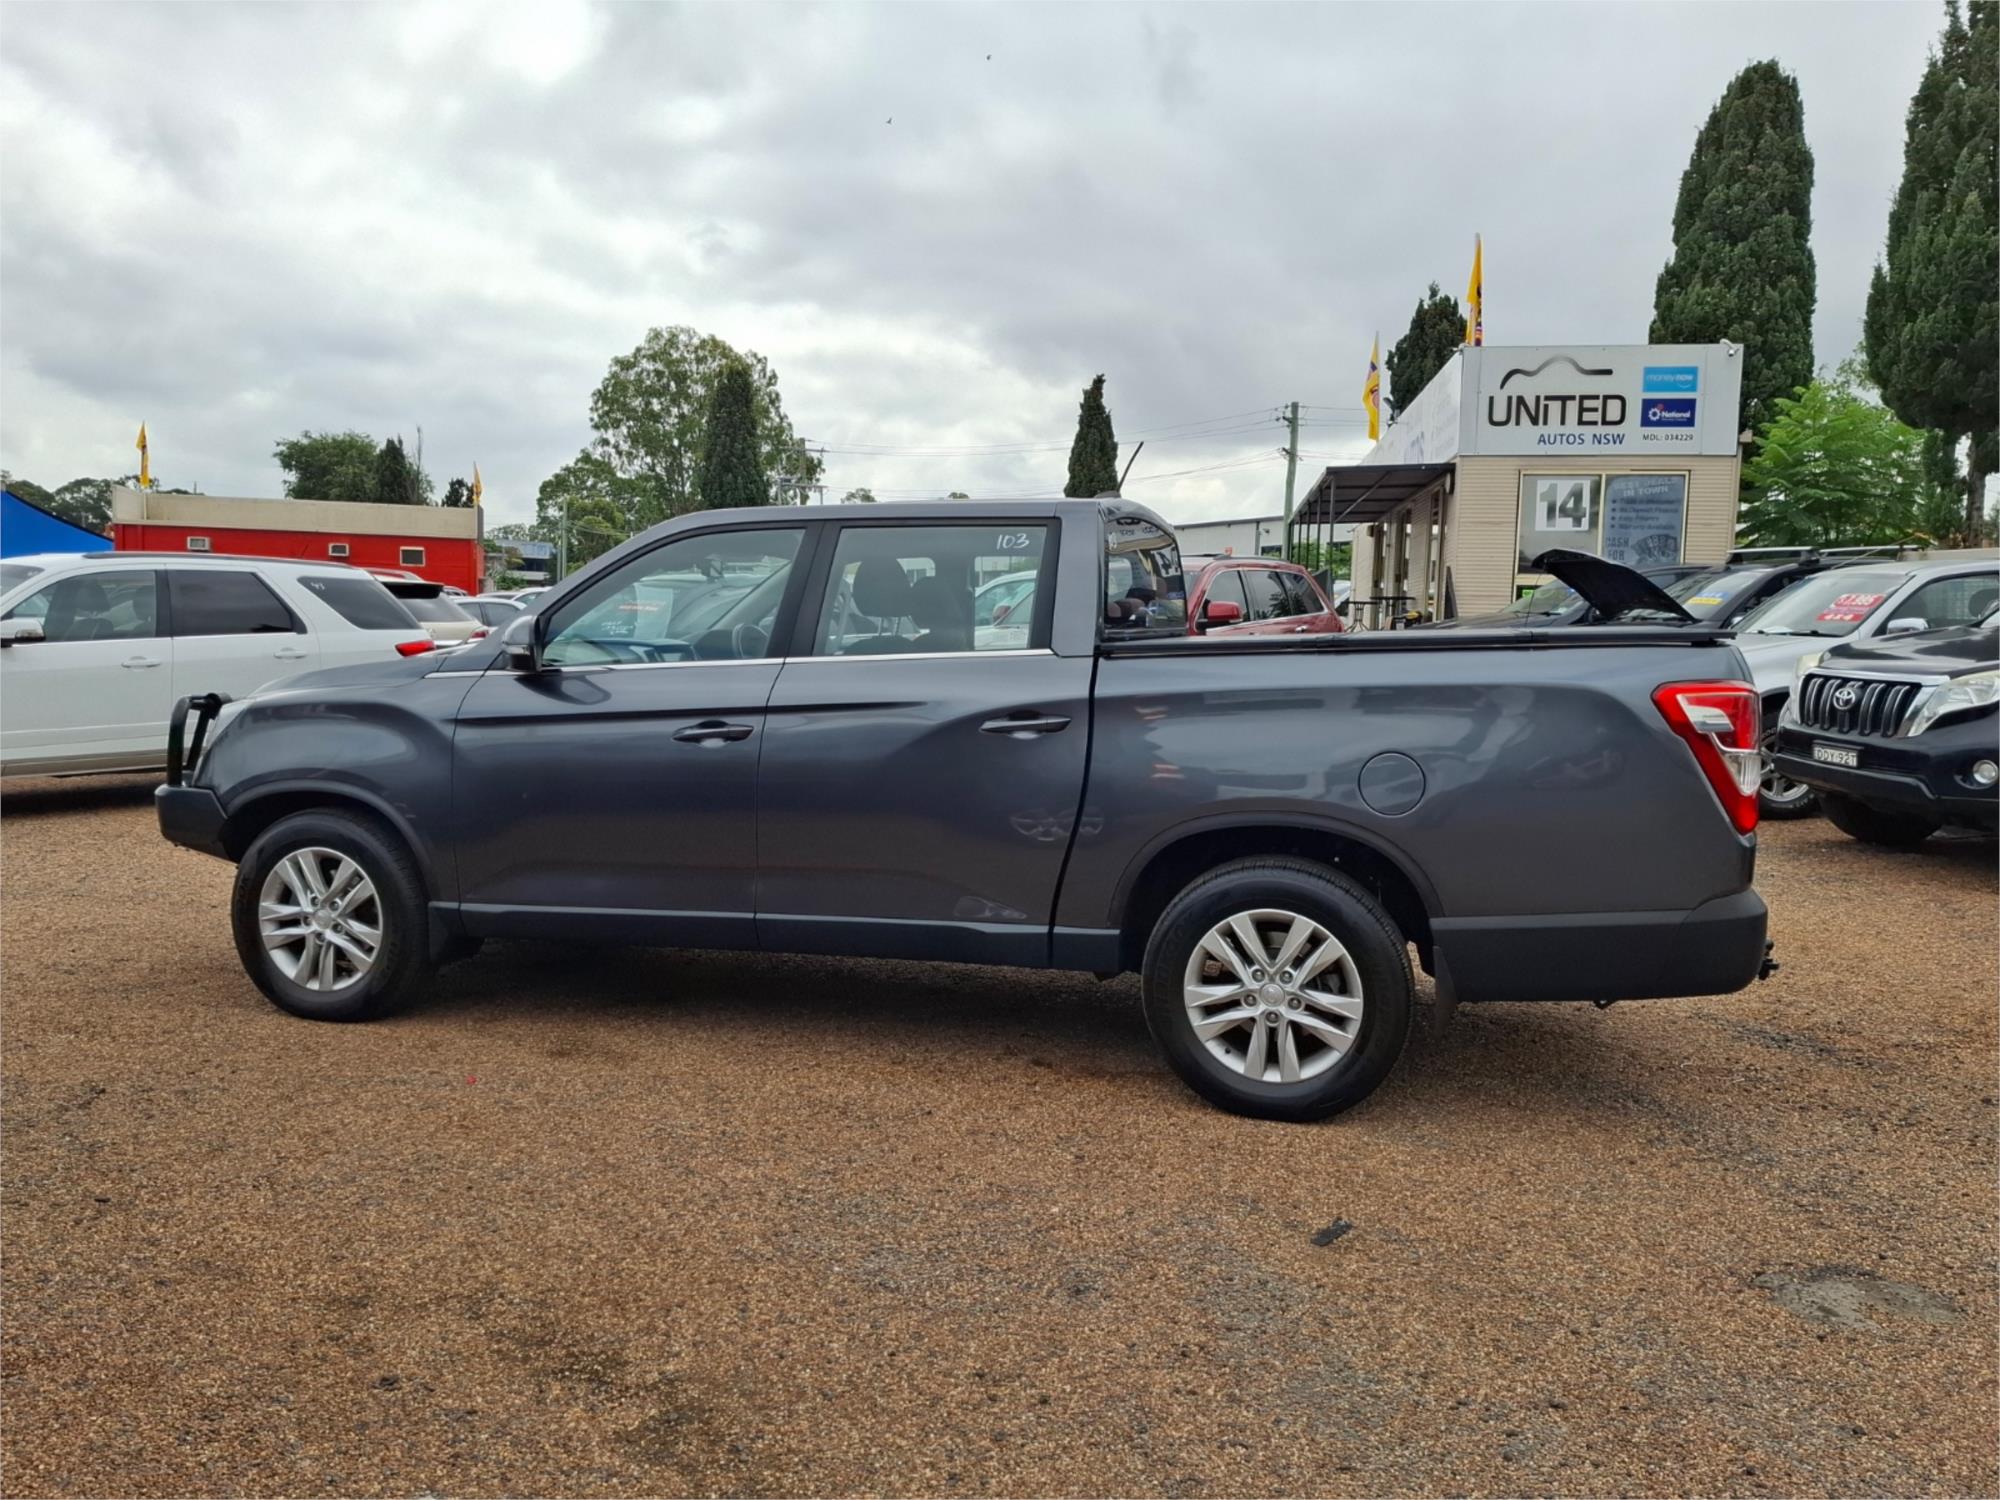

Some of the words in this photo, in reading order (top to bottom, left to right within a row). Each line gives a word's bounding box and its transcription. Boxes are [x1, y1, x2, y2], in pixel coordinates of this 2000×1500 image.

[1661, 409, 1691, 419] National
[1537, 433, 1585, 446] AUTOS
[1592, 433, 1626, 446] NSW
[1639, 485, 1669, 496] TOWN
[1539, 482, 1587, 528] 14
[996, 532, 1030, 550] 103
